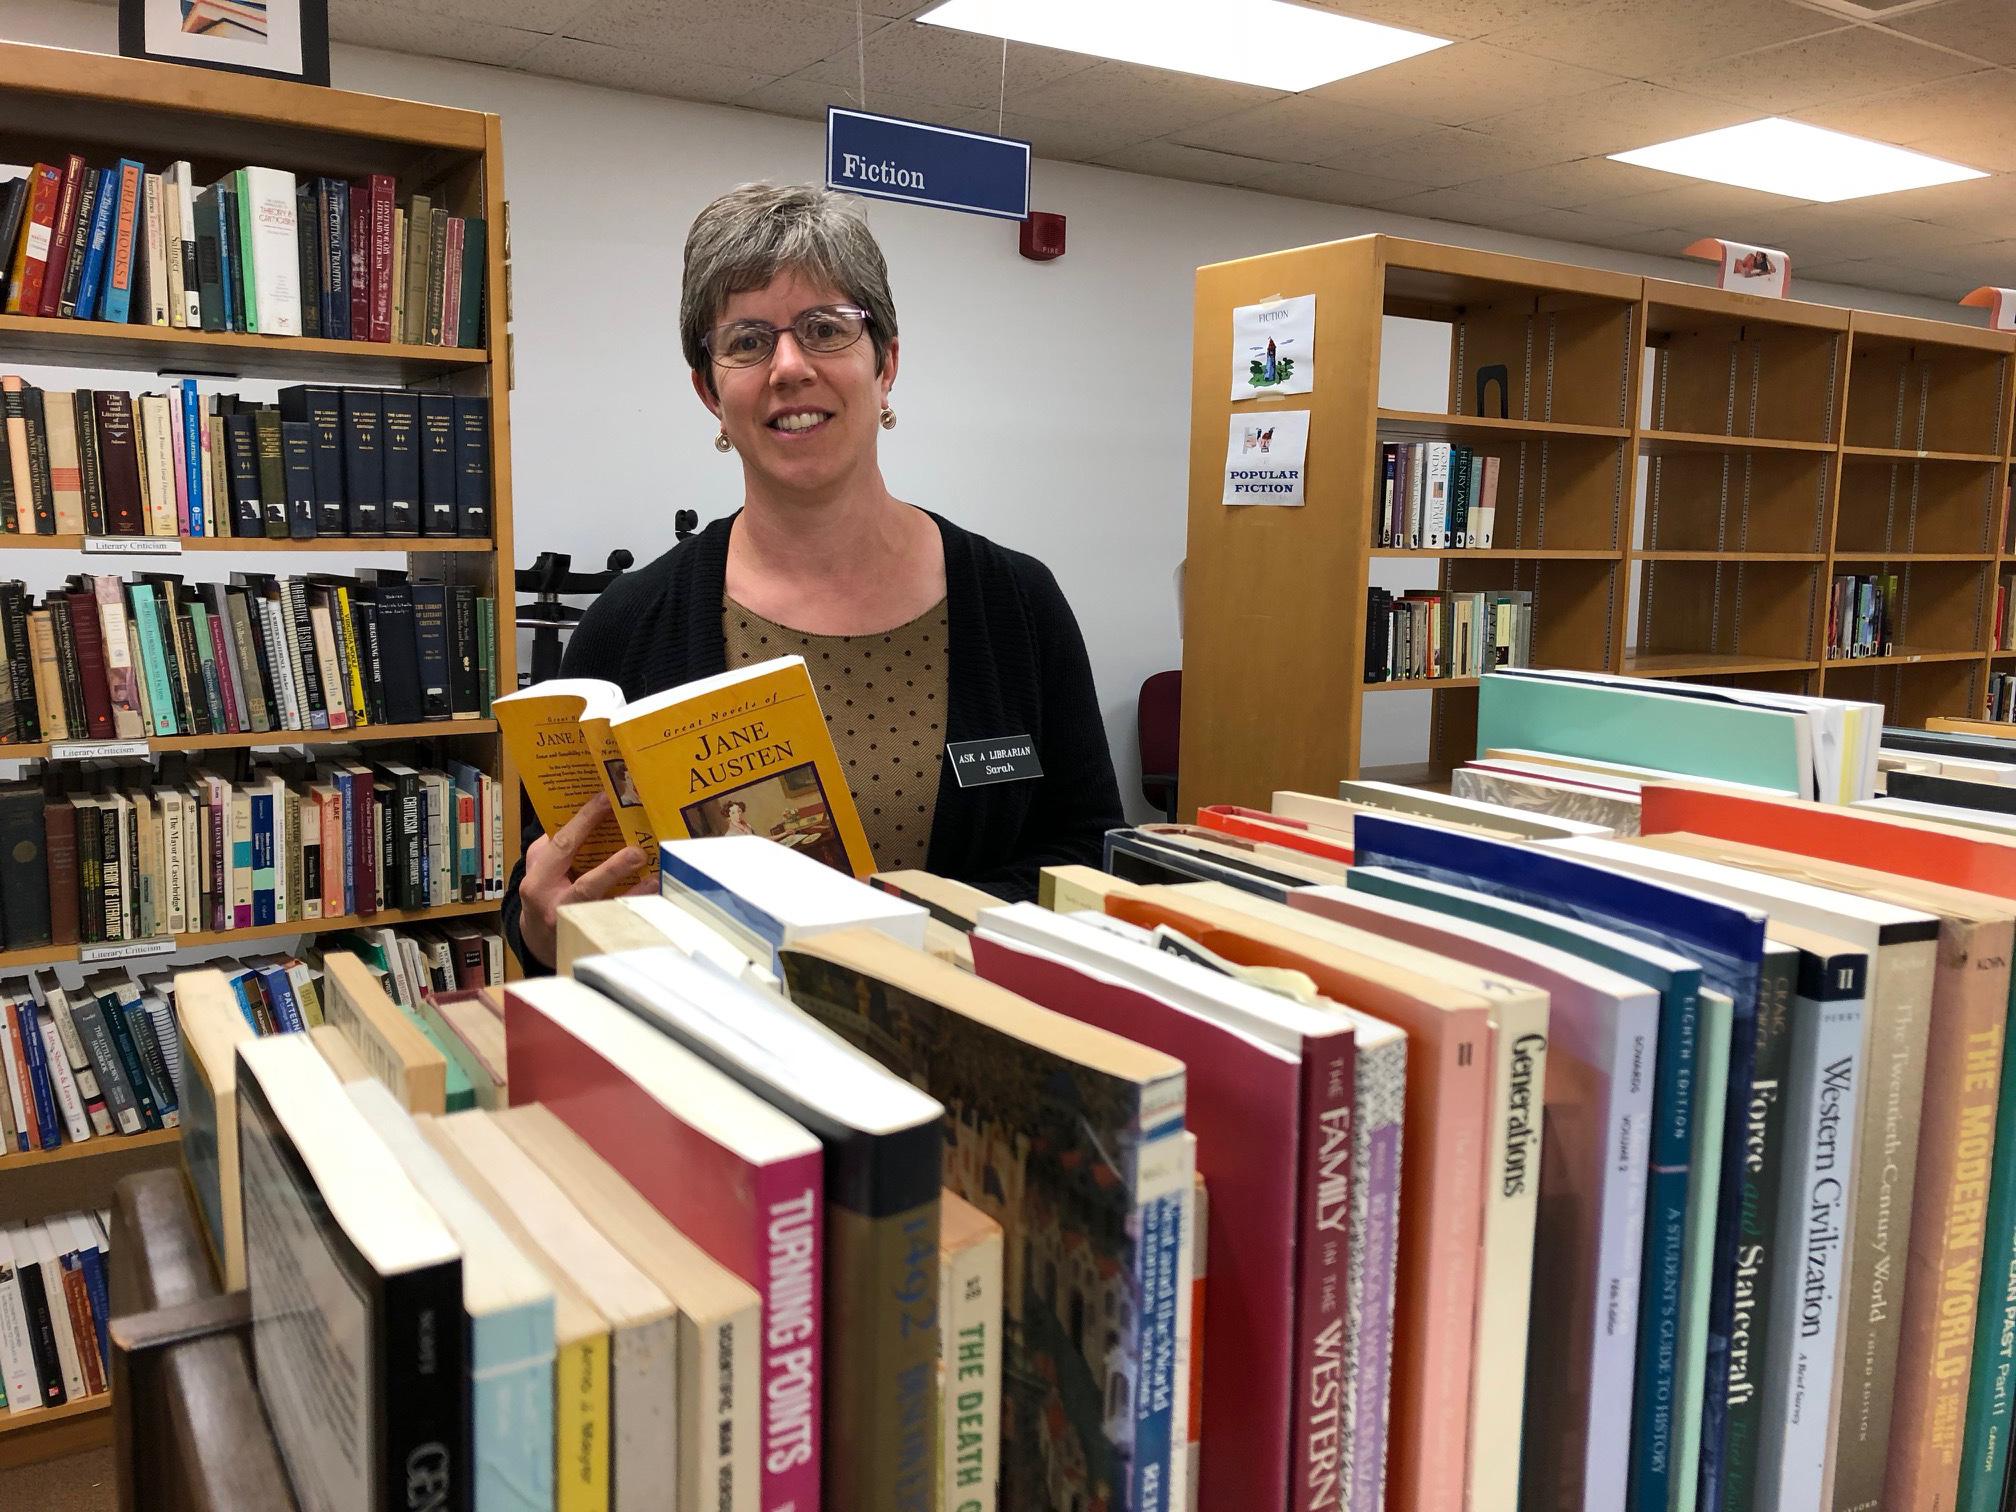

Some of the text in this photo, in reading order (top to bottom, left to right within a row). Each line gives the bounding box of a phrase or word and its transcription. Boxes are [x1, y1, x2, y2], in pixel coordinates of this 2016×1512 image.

[842, 153, 925, 190] Fiction
[80, 190, 95, 218] Mother
[74, 226, 87, 246] Gold
[115, 176, 136, 277] GREAT BOOKS
[329, 196, 342, 293] THE CRITICAL TRADITION
[171, 236, 182, 272] Salinger
[376, 232, 384, 269] CRITICISM
[1258, 310, 1289, 324] FICTION
[83, 410, 96, 494] VICTORIANS LITERATURE
[1431, 446, 1440, 476] VIDAL
[1230, 470, 1299, 480] POPULAR
[1234, 484, 1294, 493] FICTION
[1456, 450, 1468, 523] HENRY JAMES
[95, 539, 167, 551] Literary Criticism
[291, 584, 308, 623] NARRATIVE
[11, 612, 25, 648] Triumph
[235, 620, 249, 670] Wallace Stevens
[297, 626, 313, 652] DESIGN
[344, 613, 358, 668] VIRGINIA WOOLF
[67, 662, 75, 682] NOVEL
[368, 622, 381, 683] BEGINNING THEORY
[325, 658, 338, 697] Pamela
[663, 691, 778, 738] Great Novels of
[62, 747, 134, 758] Literary Criticism
[536, 731, 575, 746] JANE
[694, 721, 769, 762] JANE
[959, 746, 1031, 764] ASK A LIBRARIAN
[689, 740, 794, 794] AUSTEN
[985, 762, 1014, 775] Sarah
[169, 817, 178, 829] The
[403, 796, 418, 834] CRITICISM
[169, 830, 179, 851] Mayor
[410, 841, 418, 858] MAJOR
[103, 861, 122, 940] THEORY OF LITERATURE
[172, 861, 181, 912] Casterbridge
[92, 944, 161, 960] Literary Criticism
[283, 992, 301, 1032] PATTERN
[1823, 1012, 1861, 1023] PERRY
[91, 1040, 107, 1074] HANDBOOK
[106, 1059, 120, 1083] BROWN
[1673, 997, 1696, 1140] EIGHTH EDITION
[52, 1050, 64, 1073] Shoots
[62, 1083, 74, 1110] Leaves
[1503, 1032, 1547, 1198] Generations
[1618, 1114, 1632, 1173] VOLUME 2
[1801, 1056, 1853, 1338] Western Civilization
[1935, 1023, 2000, 1388] THE MODERN WORLD:
[1727, 1079, 1779, 1406] Force and Statecraft
[1859, 1005, 1913, 1442] The Twentieth-Century World THIRD EDITION
[1308, 1057, 1350, 1512] THE FAMILY IN THE WESTERN
[767, 1188, 815, 1475] TURNING POINTS
[1606, 1301, 1618, 1337] Edition
[2000, 1307, 2016, 1358] PAST
[957, 1321, 985, 1382] THE
[1651, 1208, 1681, 1475] A STUDENT'S GUIDE TO HISTORY
[1791, 1353, 1808, 1425] A Brief Survey
[1994, 1362, 2010, 1401] Part
[956, 1391, 984, 1489] DEATH
